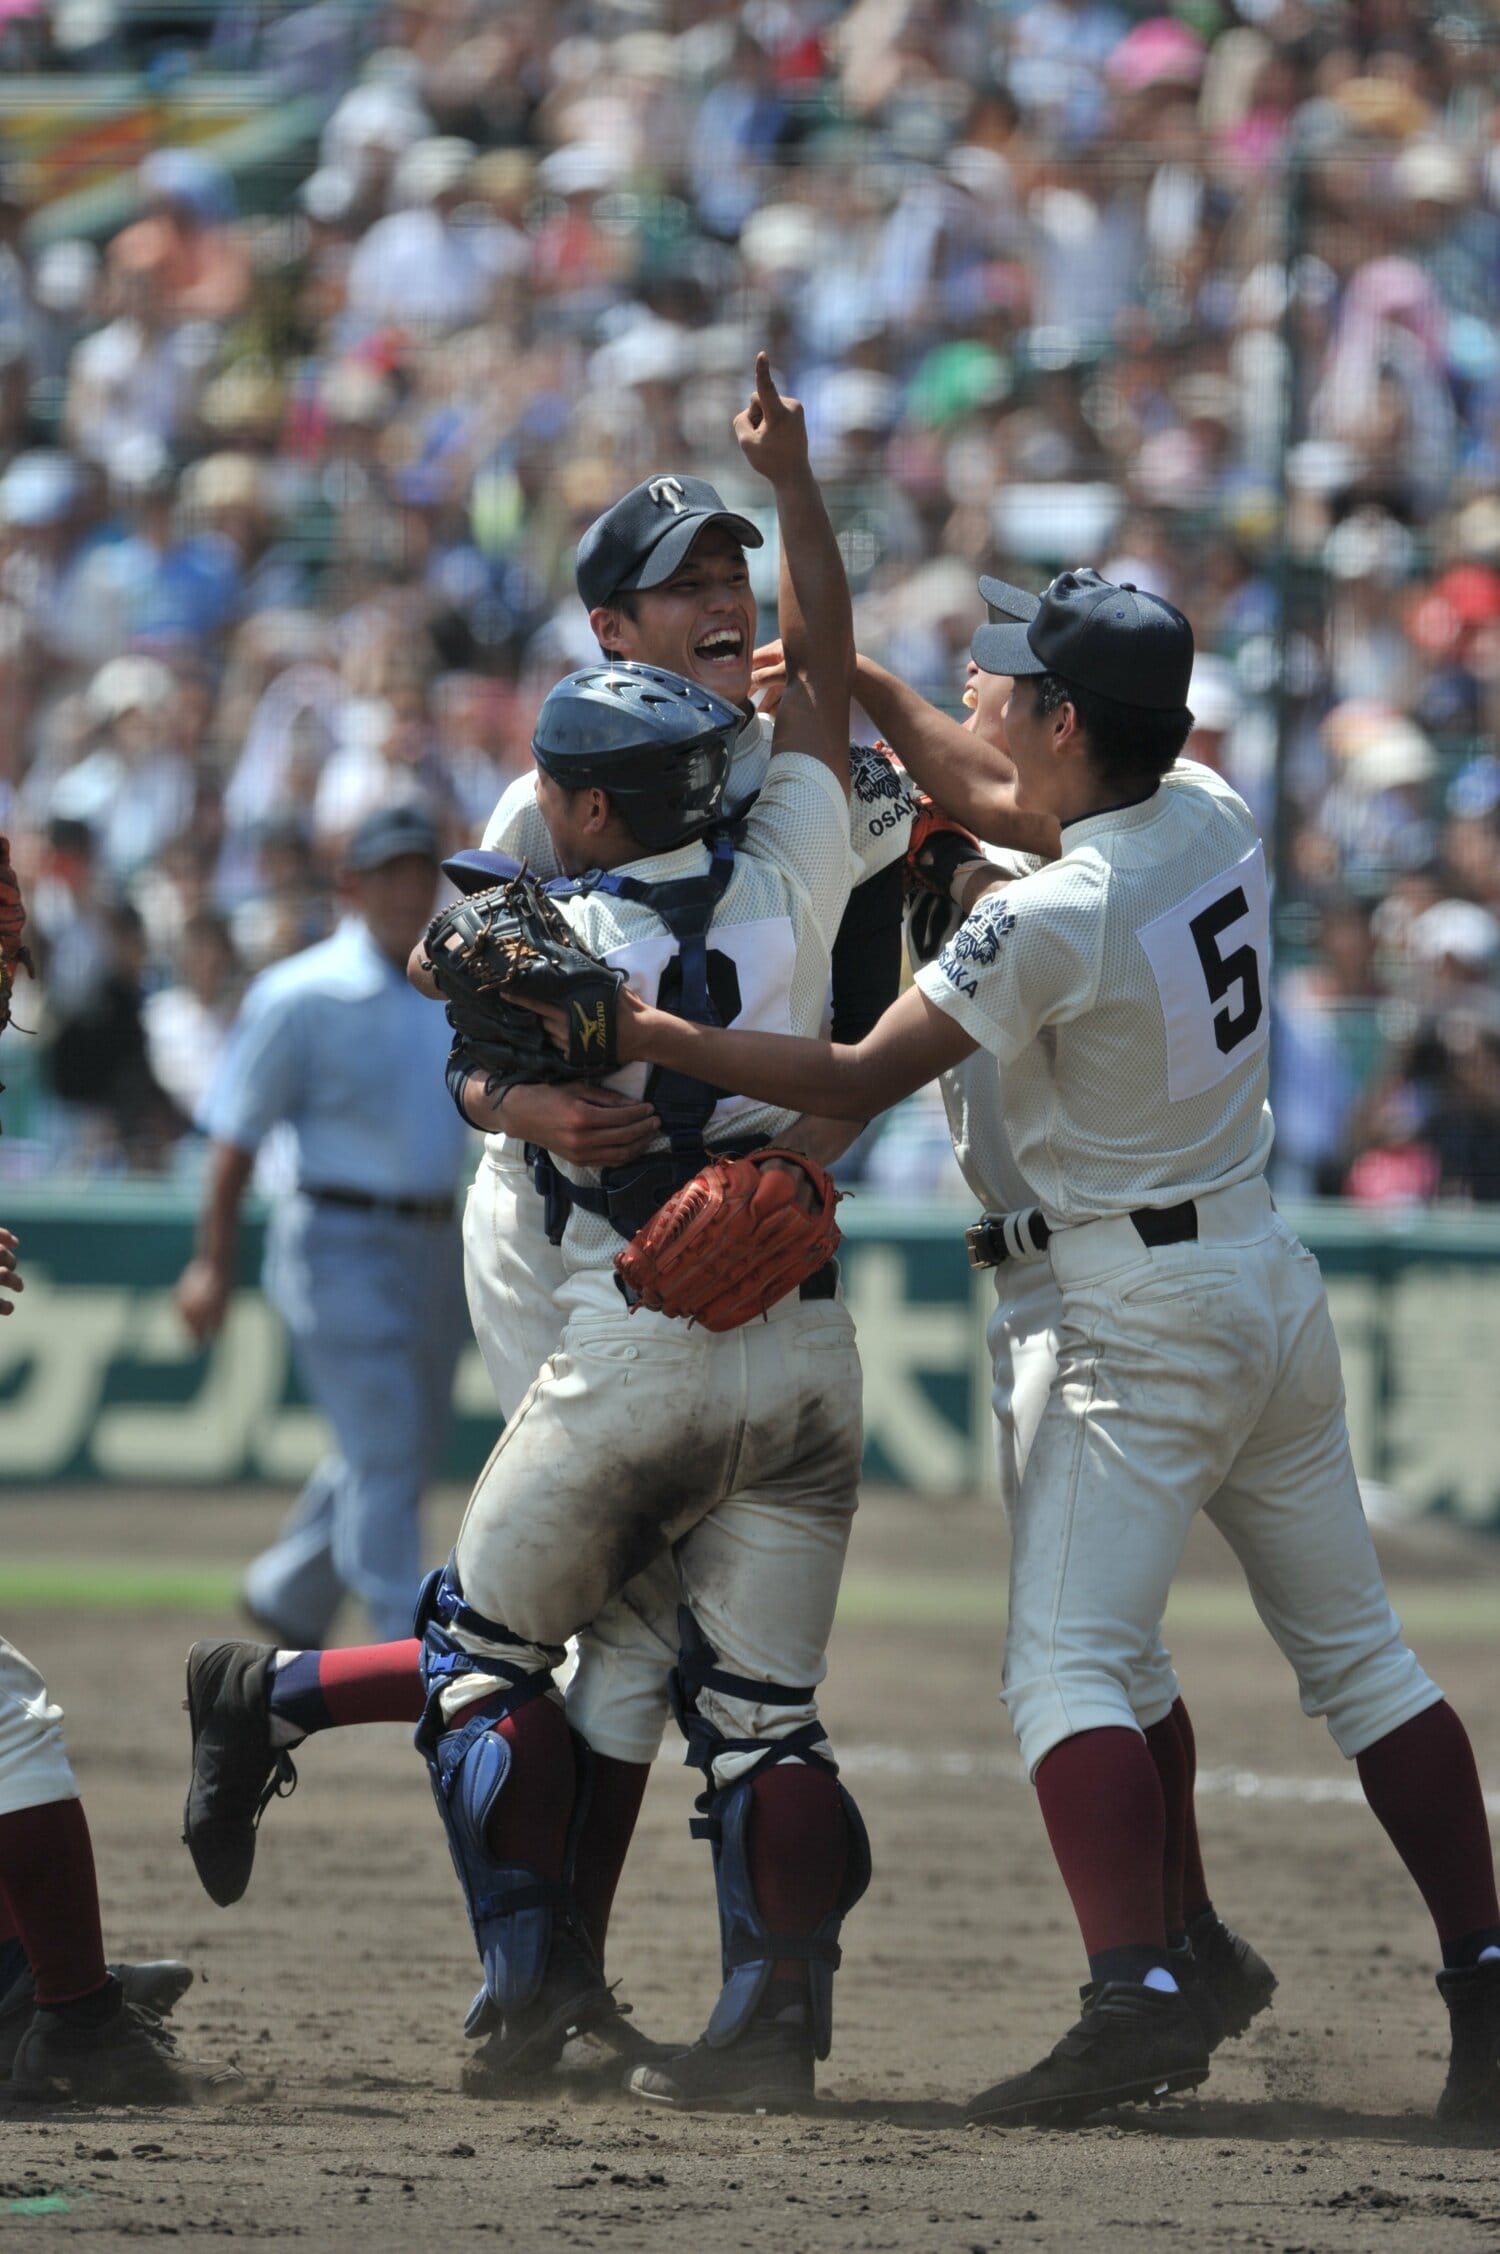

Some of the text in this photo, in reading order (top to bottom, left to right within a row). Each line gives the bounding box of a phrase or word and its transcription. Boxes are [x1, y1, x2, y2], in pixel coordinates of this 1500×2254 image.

[648, 476, 690, 516] T
[868, 791, 920, 837] OSAK
[938, 949, 979, 999] SAKA
[1188, 885, 1263, 1056] 5
